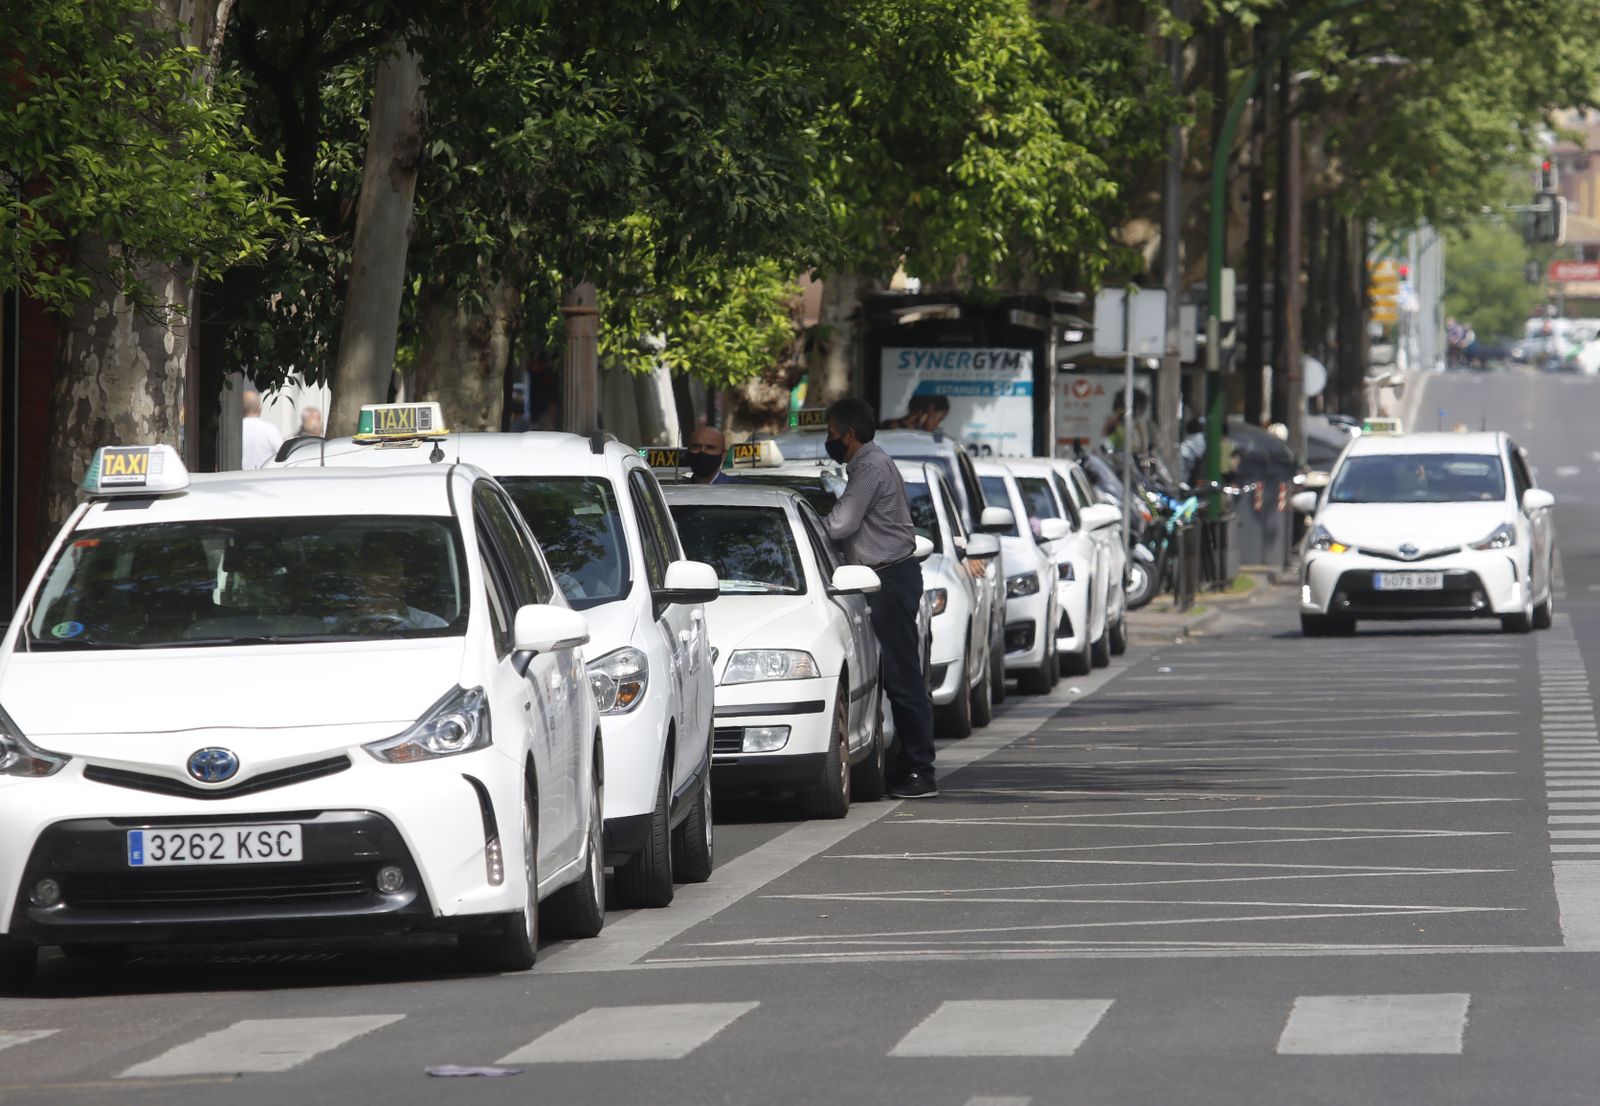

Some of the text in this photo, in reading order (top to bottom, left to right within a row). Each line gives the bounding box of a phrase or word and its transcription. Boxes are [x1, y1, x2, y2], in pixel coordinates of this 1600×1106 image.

[898, 351, 1021, 369] SYNERGYM
[377, 407, 416, 430] TAXI
[735, 445, 760, 457] TAXI
[104, 453, 148, 475] TAXI
[150, 830, 293, 861] 3262 KSC
